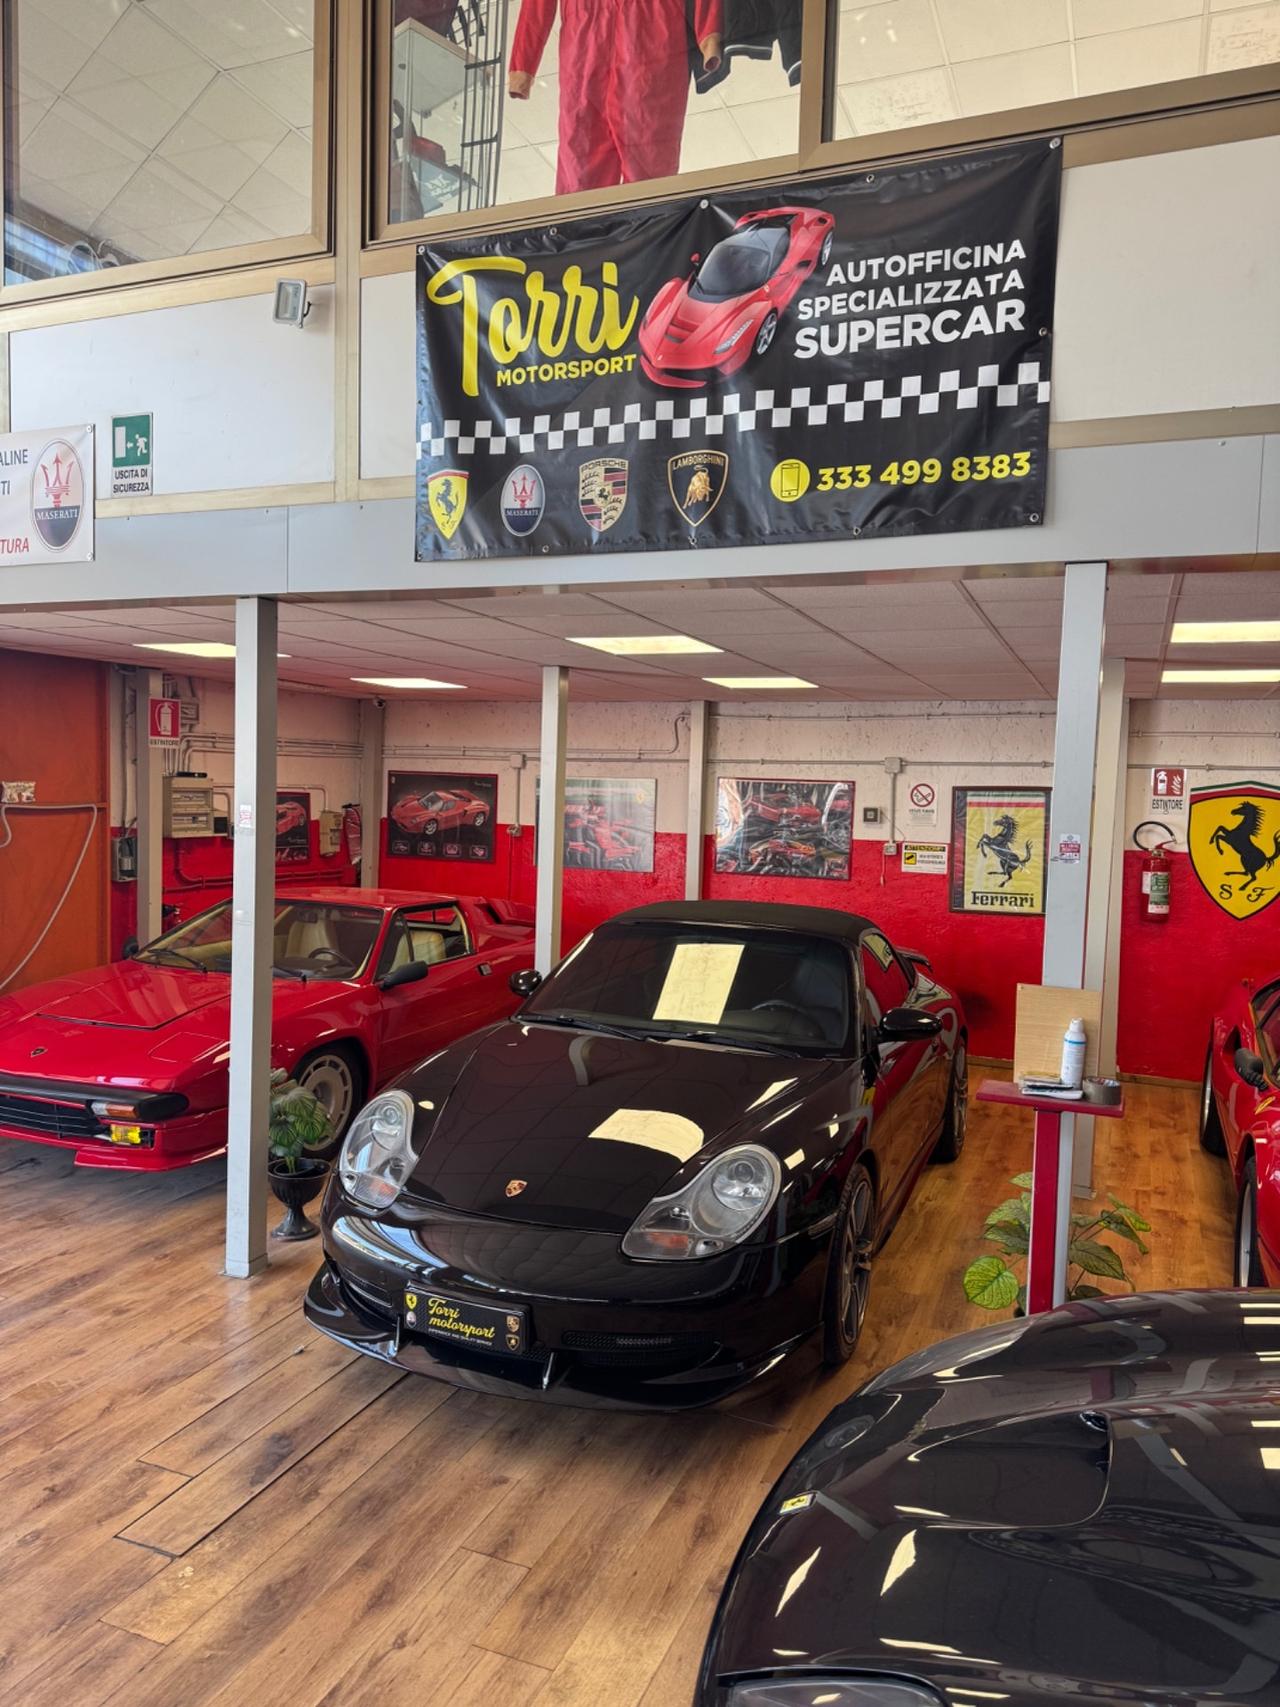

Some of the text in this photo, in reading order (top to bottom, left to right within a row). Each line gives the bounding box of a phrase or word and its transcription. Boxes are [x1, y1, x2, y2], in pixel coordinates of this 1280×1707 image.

[826, 239, 1026, 286] AUTOFFICINA
[797, 269, 1025, 320] SPECIALIZZATA
[426, 256, 640, 396] Torri
[793, 298, 1026, 359] SUPERCAR
[496, 354, 637, 387] MOTORSPORT
[581, 459, 626, 473] PORSCHE
[672, 454, 725, 470] LAMBORGHINI
[816, 451, 1031, 492] 333 499 8383
[114, 468, 148, 480] USCITA DI
[112, 481, 150, 494] SICUREZZA
[36, 508, 78, 521] MASERATI
[506, 509, 539, 517] MASERATI
[1151, 798, 1183, 811] ESTINTORE
[970, 890, 1035, 908] Ferrari
[1219, 883, 1275, 903] S F
[428, 1297, 460, 1319] Torri
[428, 1315, 496, 1338] motorsport
